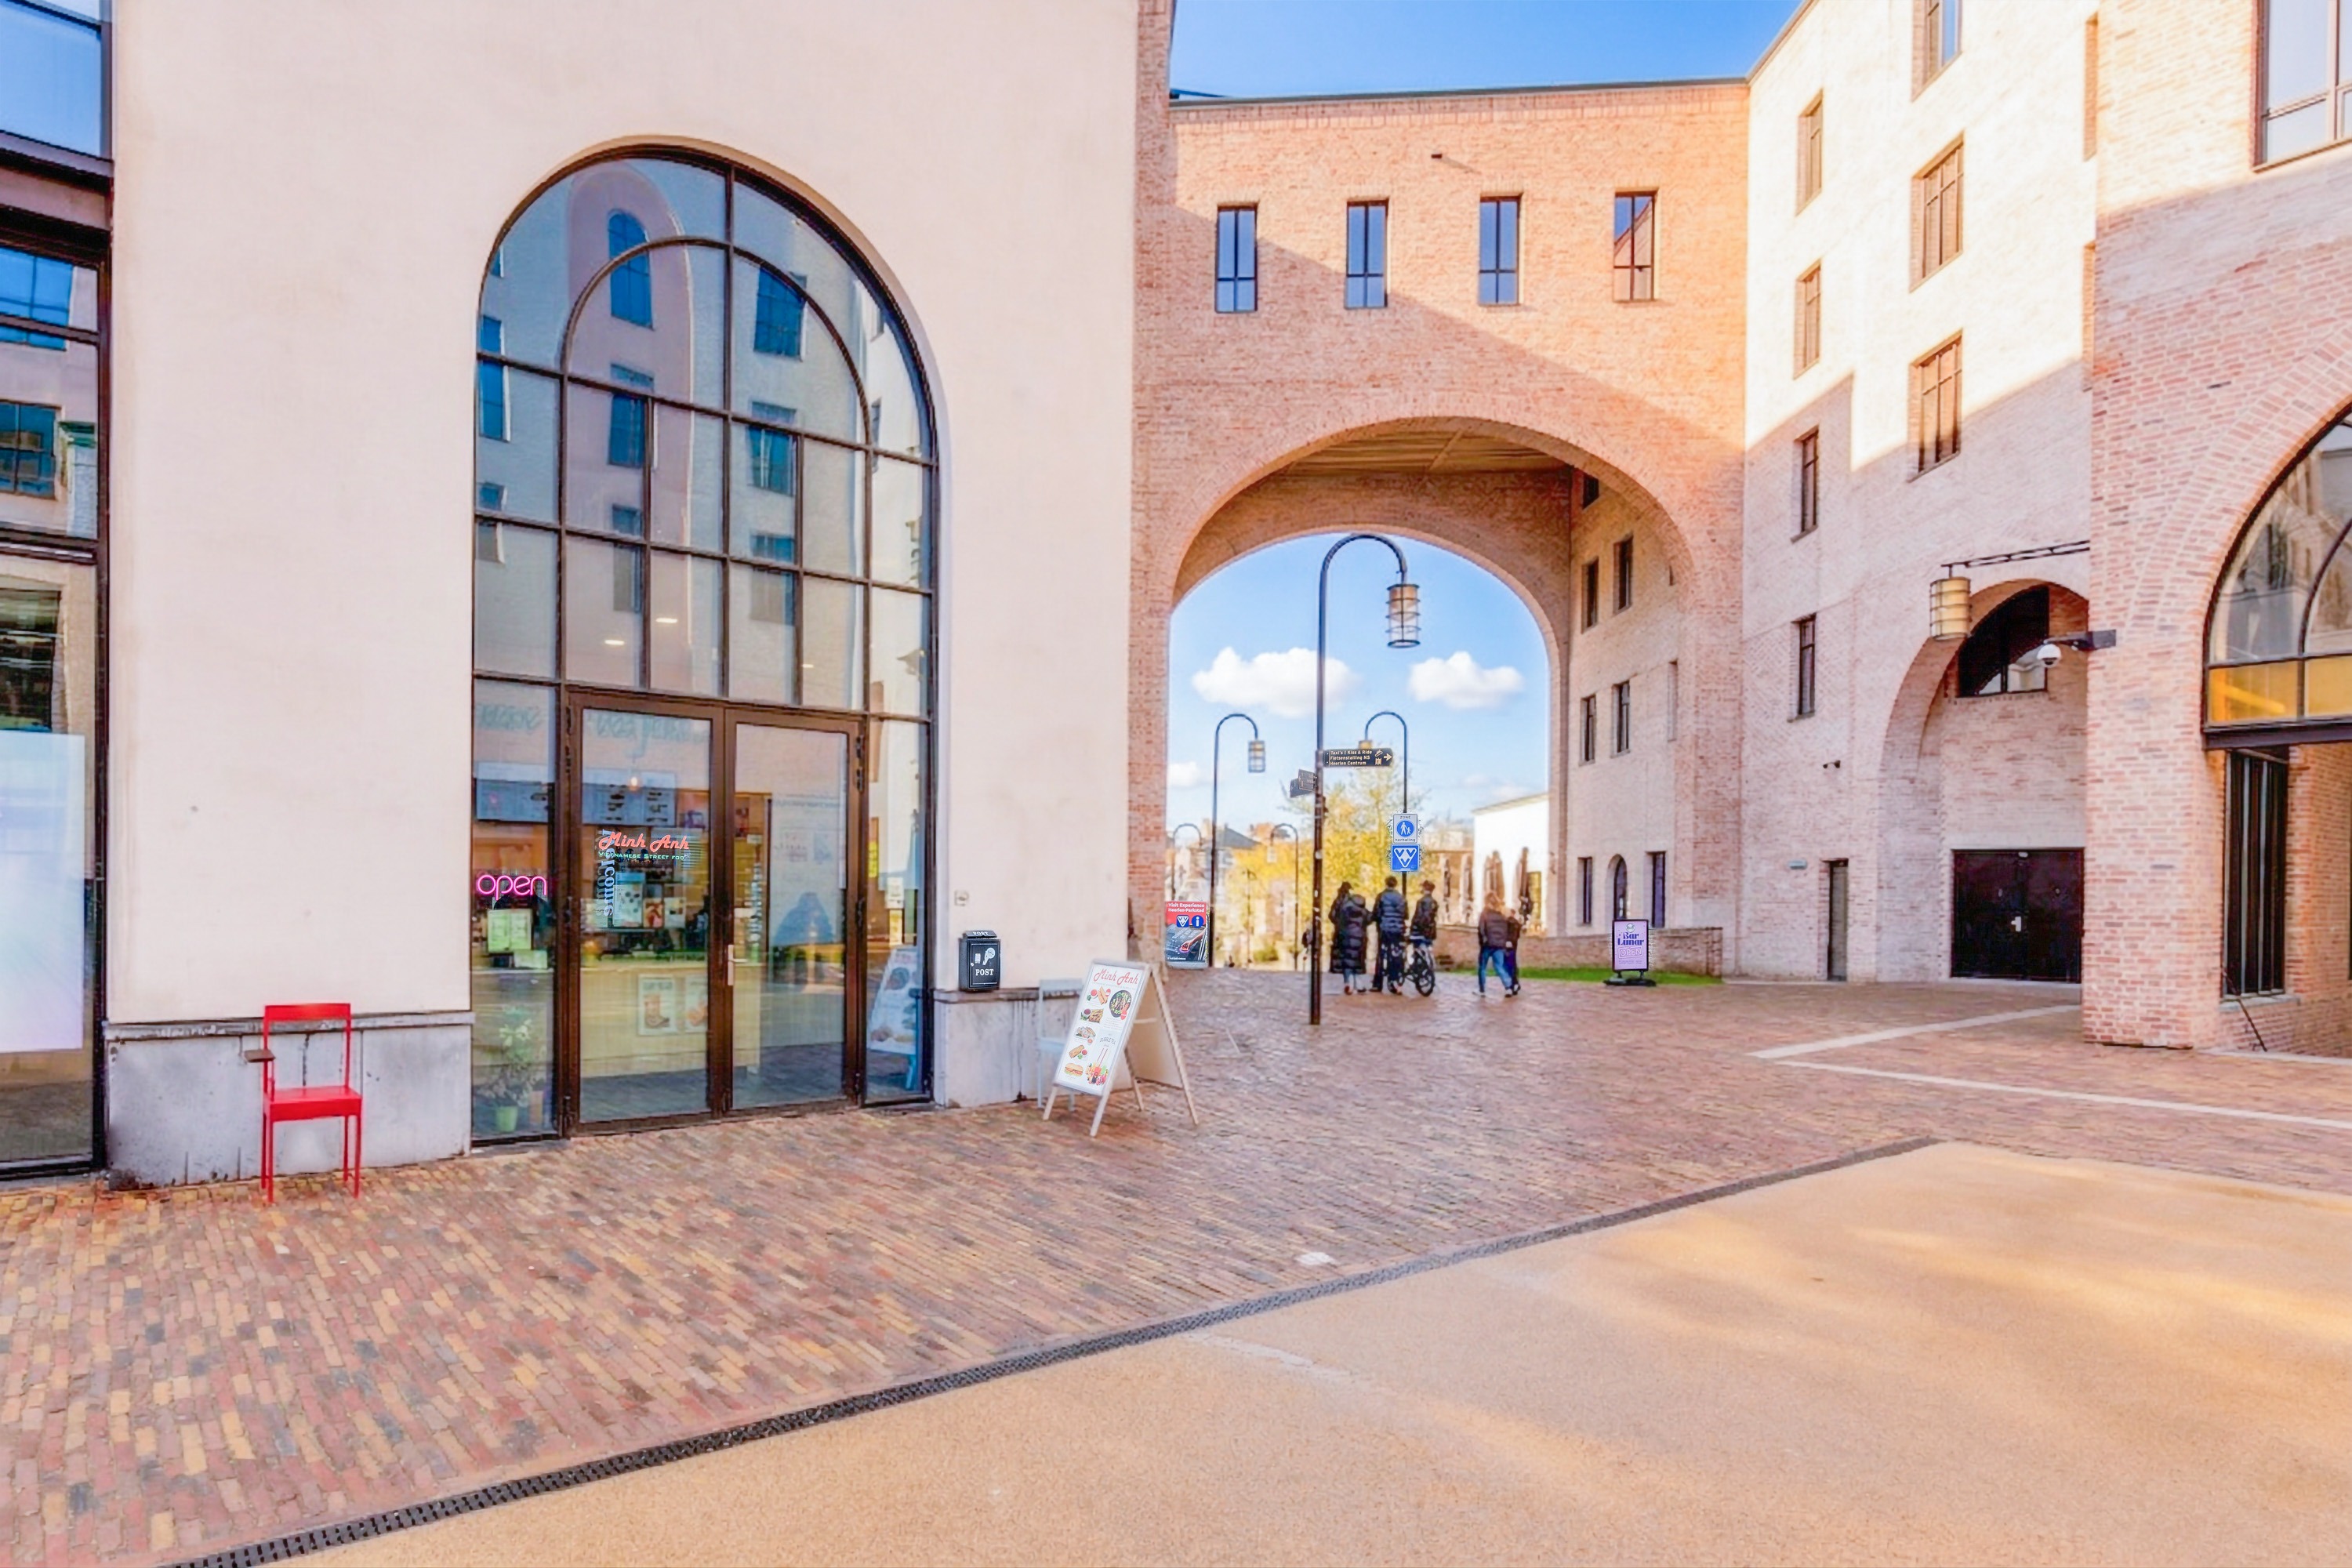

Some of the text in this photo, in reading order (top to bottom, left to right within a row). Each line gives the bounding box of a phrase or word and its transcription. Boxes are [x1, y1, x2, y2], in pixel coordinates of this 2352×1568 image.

[598, 831, 689, 853] Minh Anh
[477, 874, 548, 901] open
[1094, 969, 1138, 985] Minh Anh
